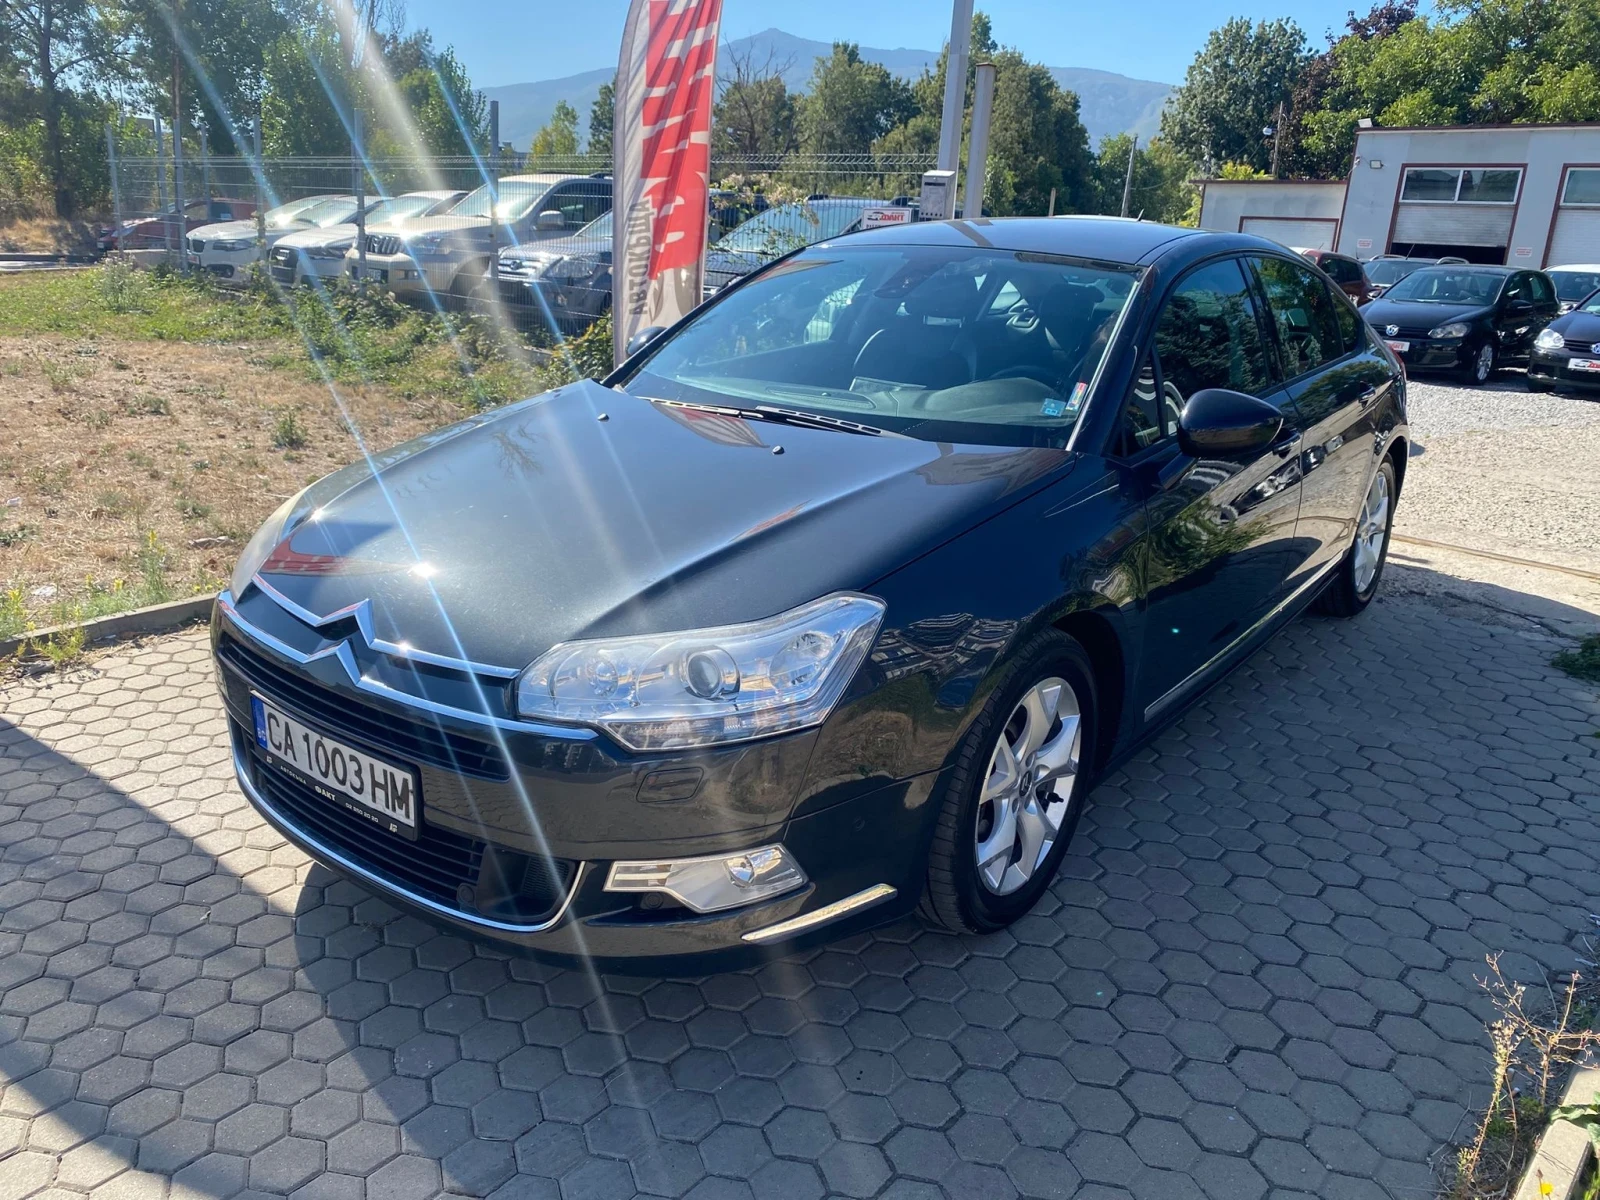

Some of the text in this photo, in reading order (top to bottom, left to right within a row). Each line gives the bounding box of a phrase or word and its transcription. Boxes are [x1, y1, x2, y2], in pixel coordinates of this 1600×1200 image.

[627, 198, 657, 316] АВТОКЪЩА
[302, 732, 365, 796] 1003
[314, 785, 336, 801] ФАКТ
